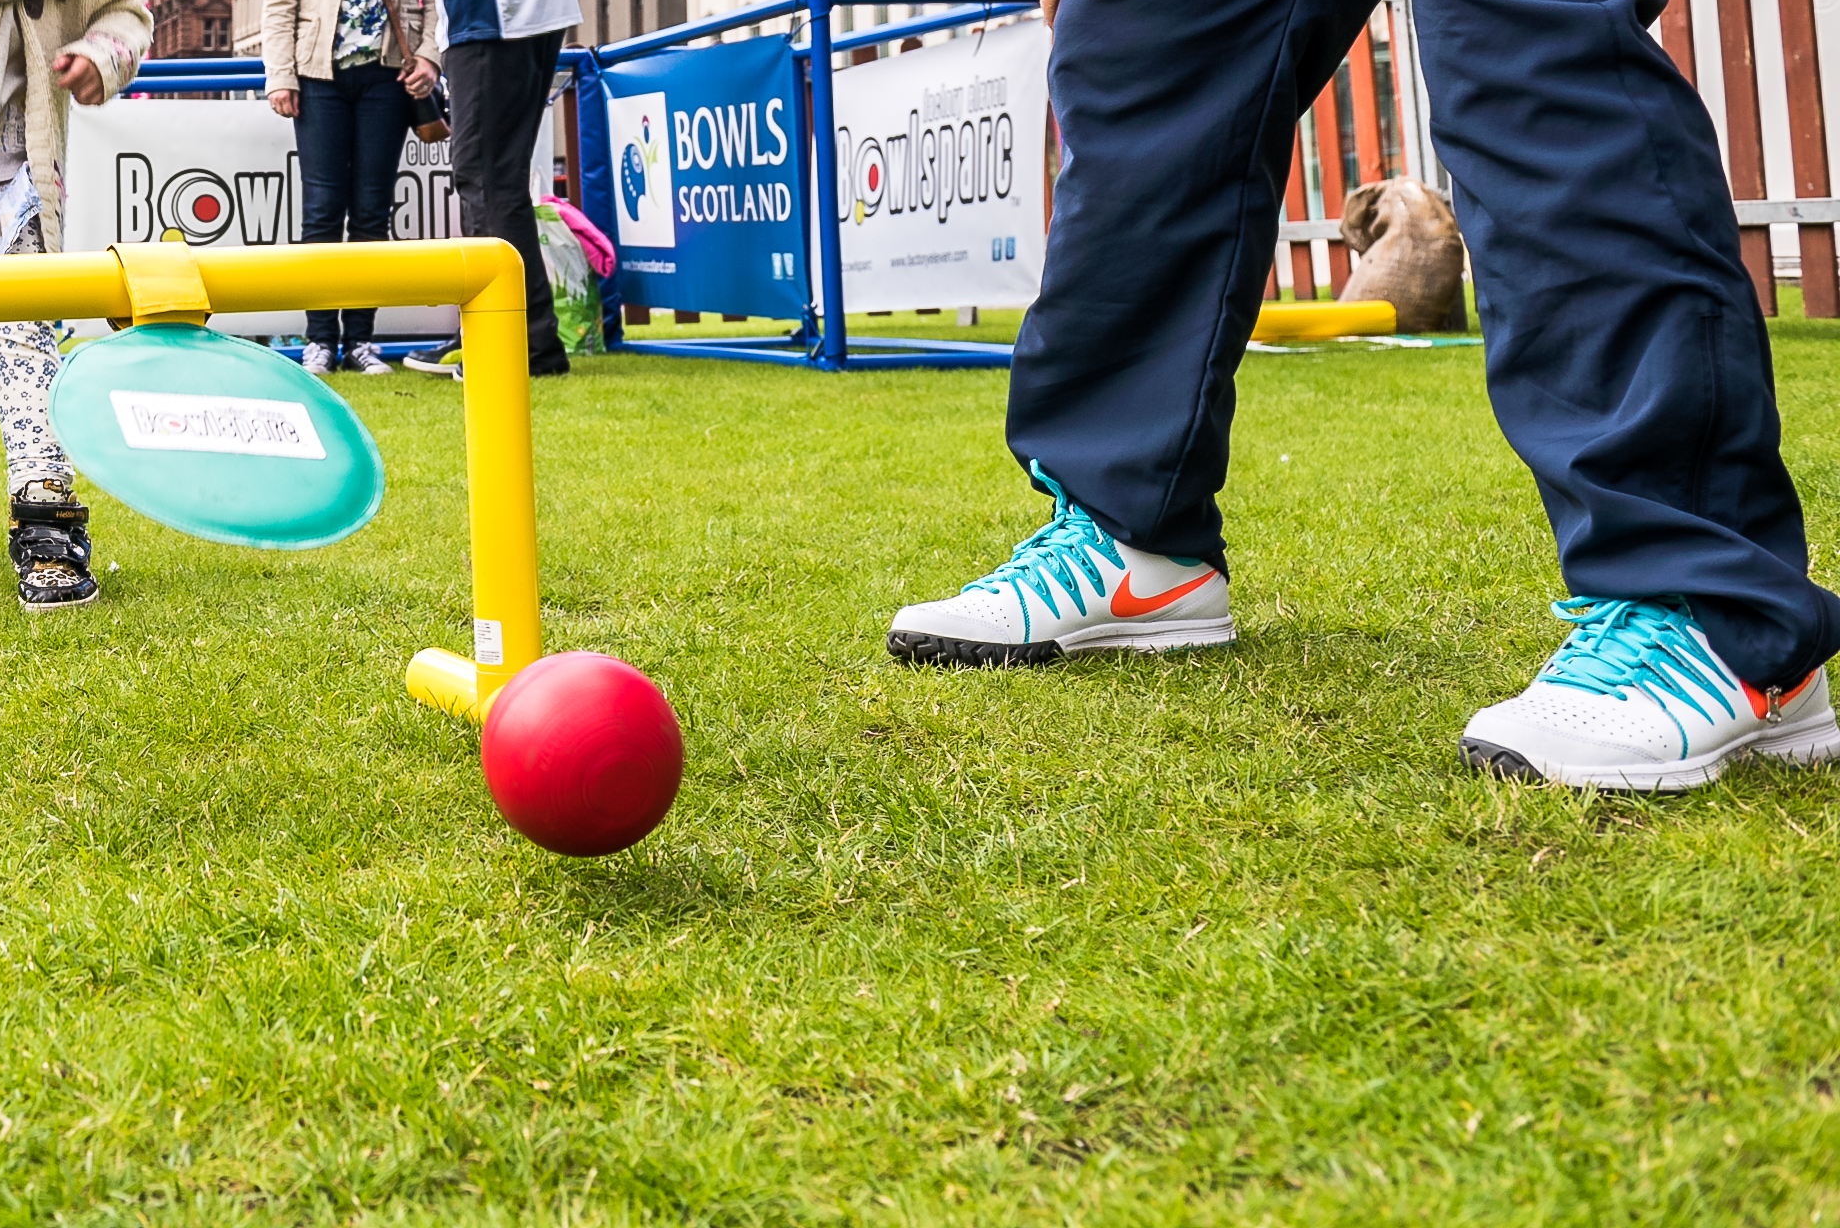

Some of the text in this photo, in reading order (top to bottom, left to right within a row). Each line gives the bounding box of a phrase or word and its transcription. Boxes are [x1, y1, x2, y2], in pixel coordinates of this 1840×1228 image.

[406, 139, 451, 166] elev
[673, 97, 789, 171] BOWLS
[837, 108, 1013, 226] Bowlsparc
[678, 182, 792, 225] SCOTLAND
